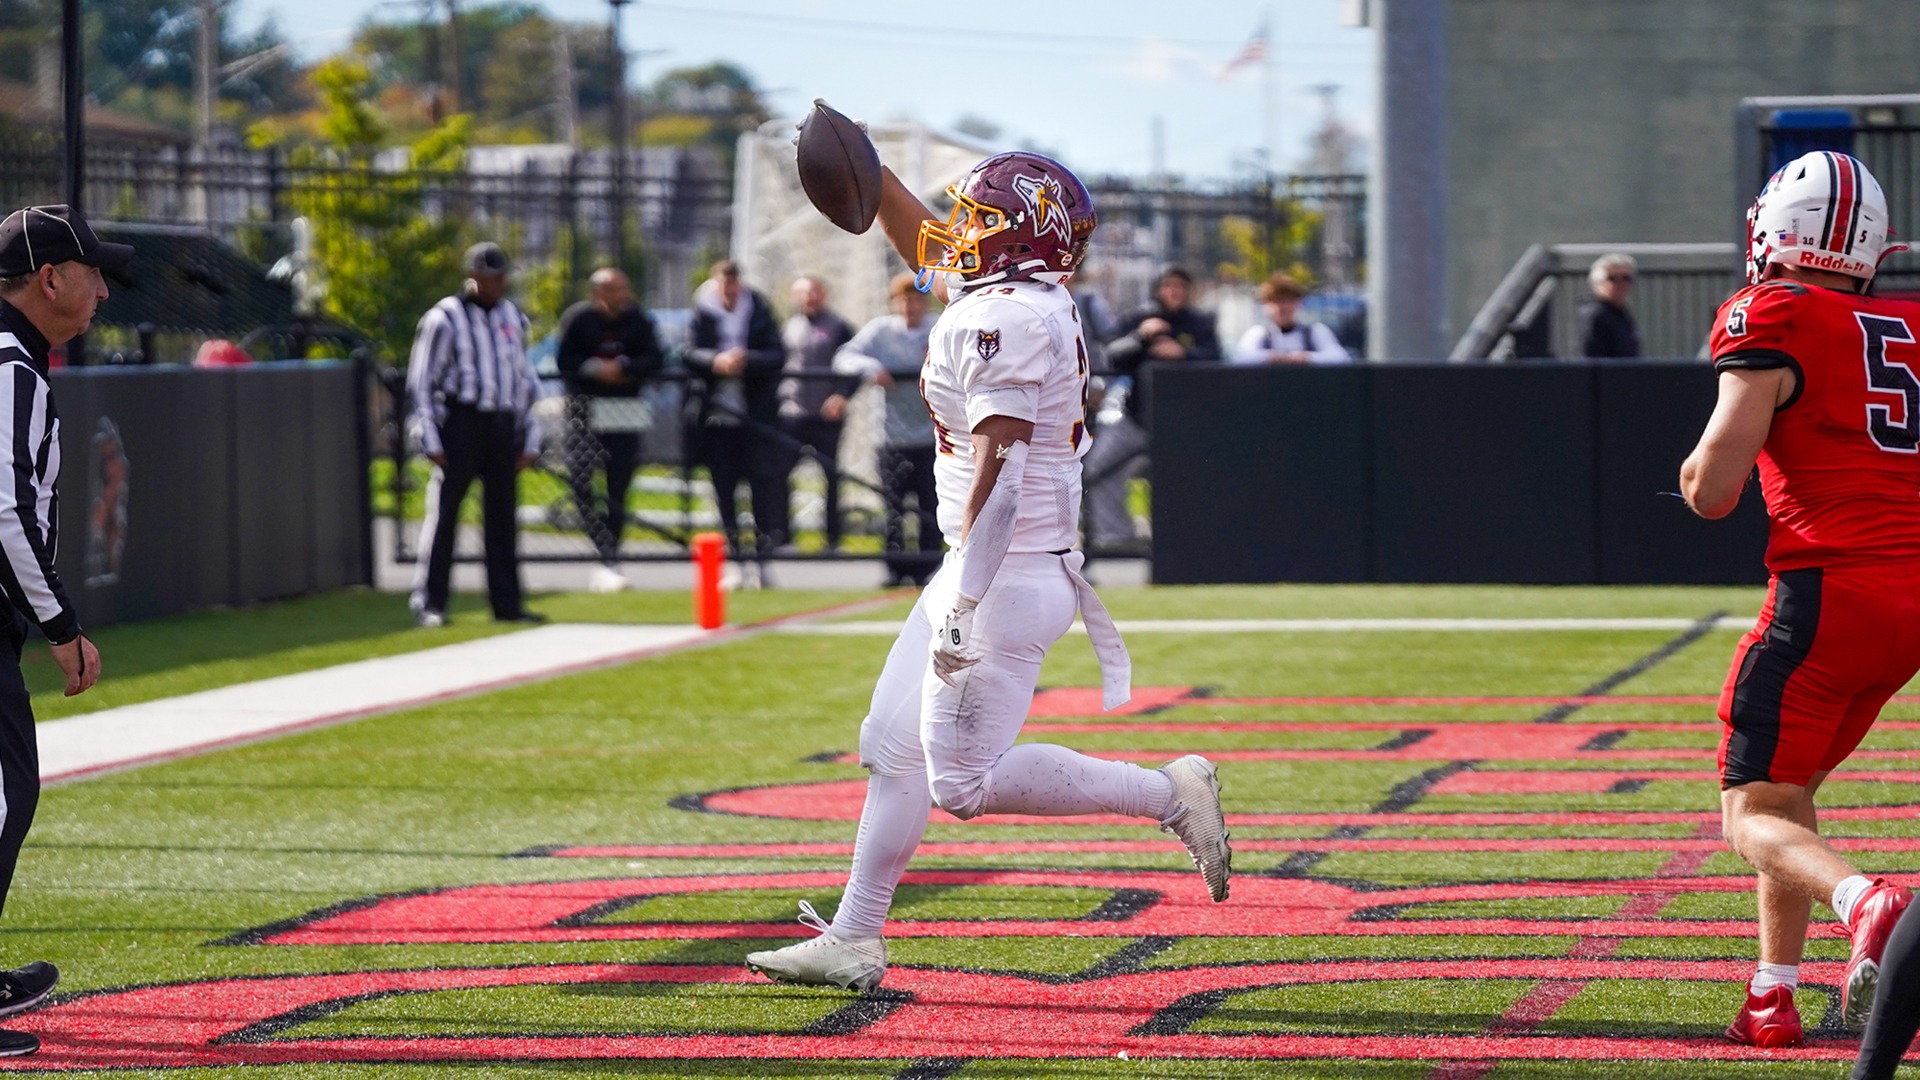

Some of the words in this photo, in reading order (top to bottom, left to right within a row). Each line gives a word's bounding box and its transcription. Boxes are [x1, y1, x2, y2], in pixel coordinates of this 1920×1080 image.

[1859, 230, 1867, 243] 5
[1726, 297, 1754, 337] 5
[1853, 311, 1920, 454] 5
